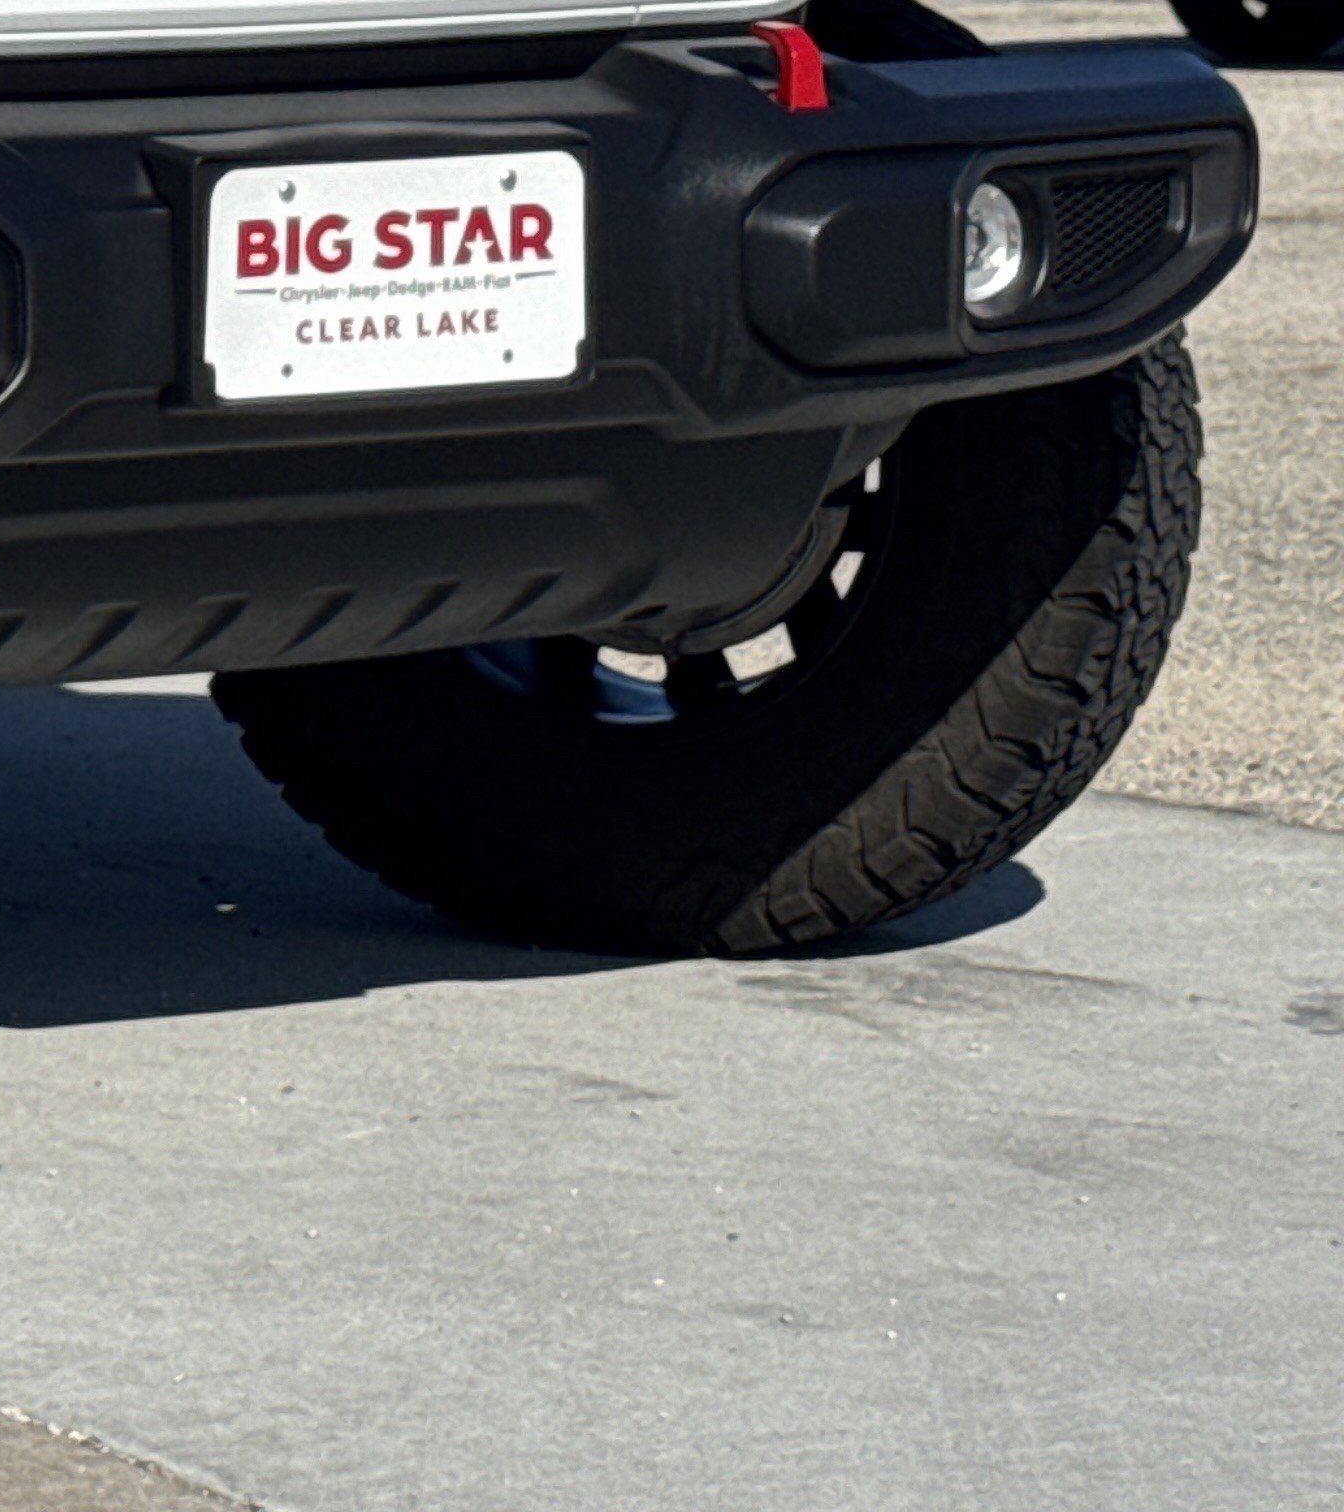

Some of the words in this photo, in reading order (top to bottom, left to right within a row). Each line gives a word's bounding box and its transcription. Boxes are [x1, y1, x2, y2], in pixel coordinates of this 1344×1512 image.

[236, 214, 354, 279] BIG
[373, 203, 554, 269] STAR
[295, 314, 403, 345] CLEAR
[415, 307, 500, 338] LAKE
